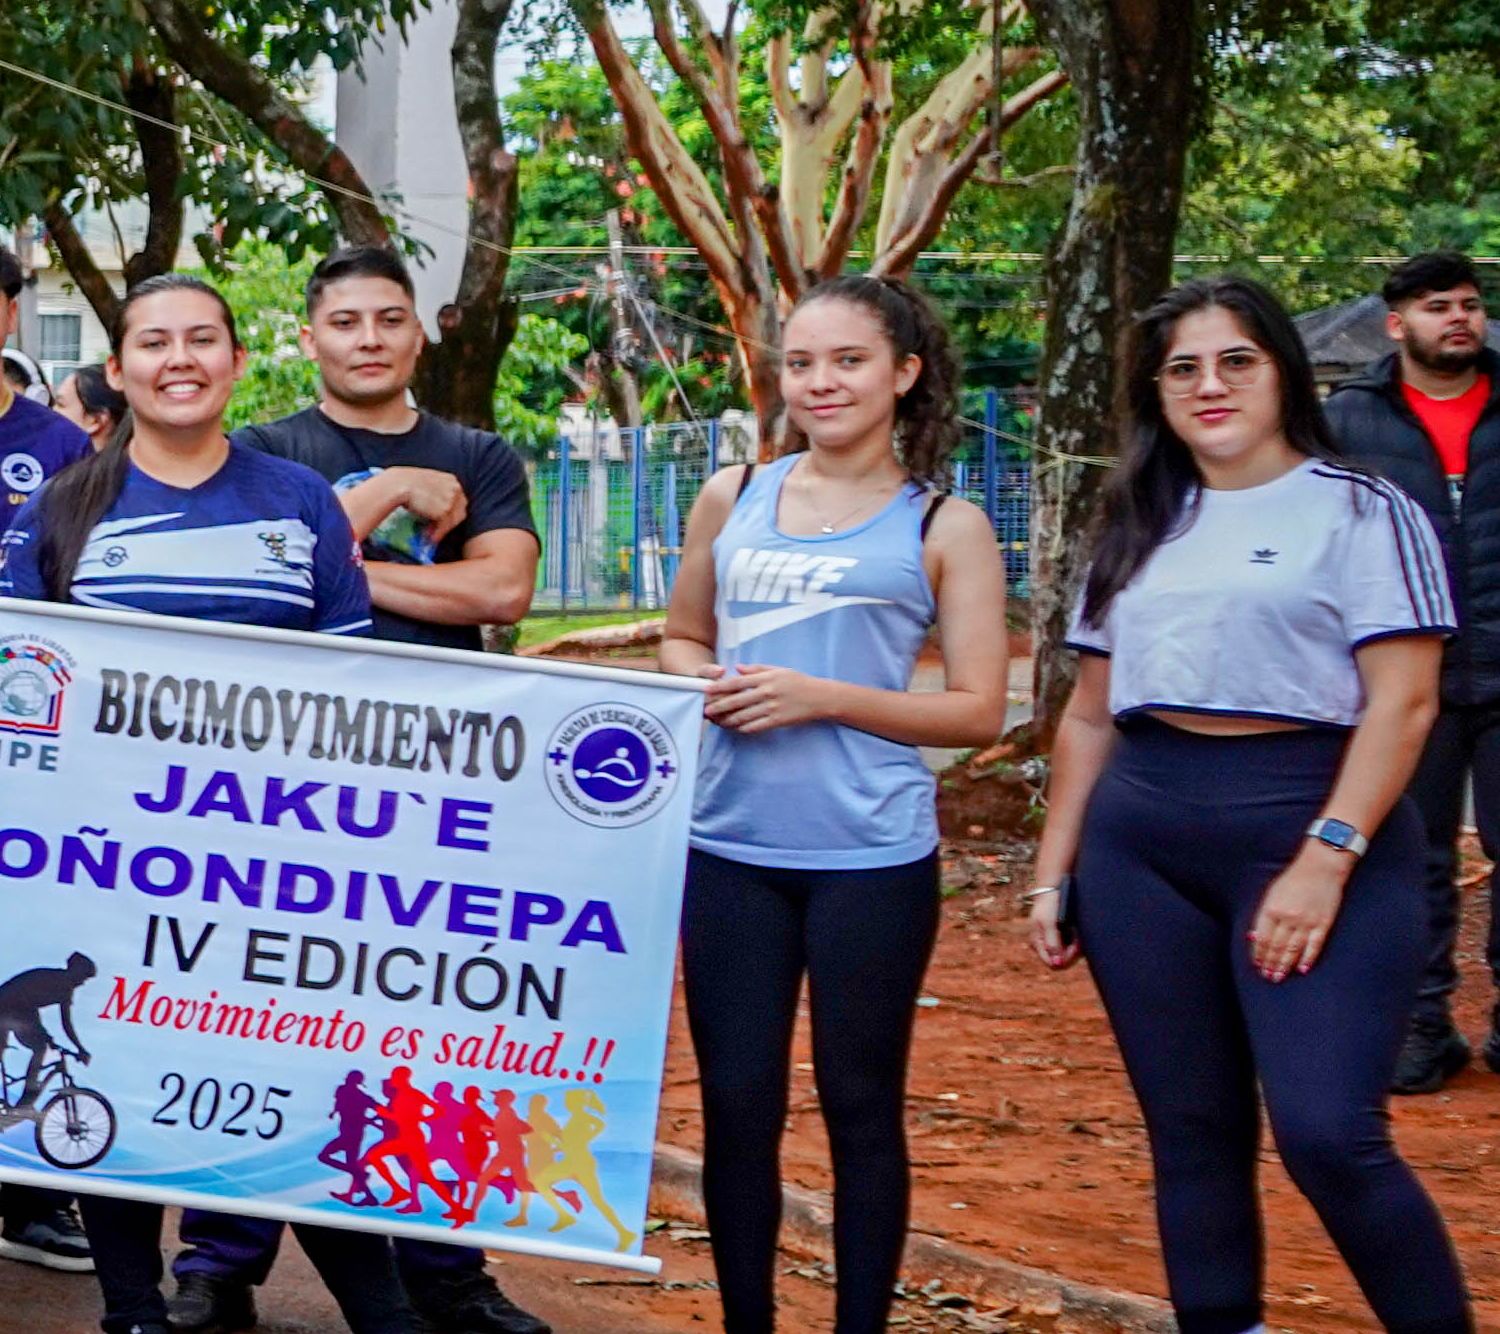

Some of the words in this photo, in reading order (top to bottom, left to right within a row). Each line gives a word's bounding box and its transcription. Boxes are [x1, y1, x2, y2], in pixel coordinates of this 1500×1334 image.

[726, 547, 861, 603] NIKE
[93, 667, 525, 783] BICIMOVIMIENTO
[142, 914, 219, 973] IV
[241, 928, 567, 1021] EDICIÓN
[97, 975, 367, 1054] Movimiento
[379, 1025, 425, 1060] es
[433, 1024, 617, 1085] salud.!!
[152, 1071, 293, 1141] 2025
